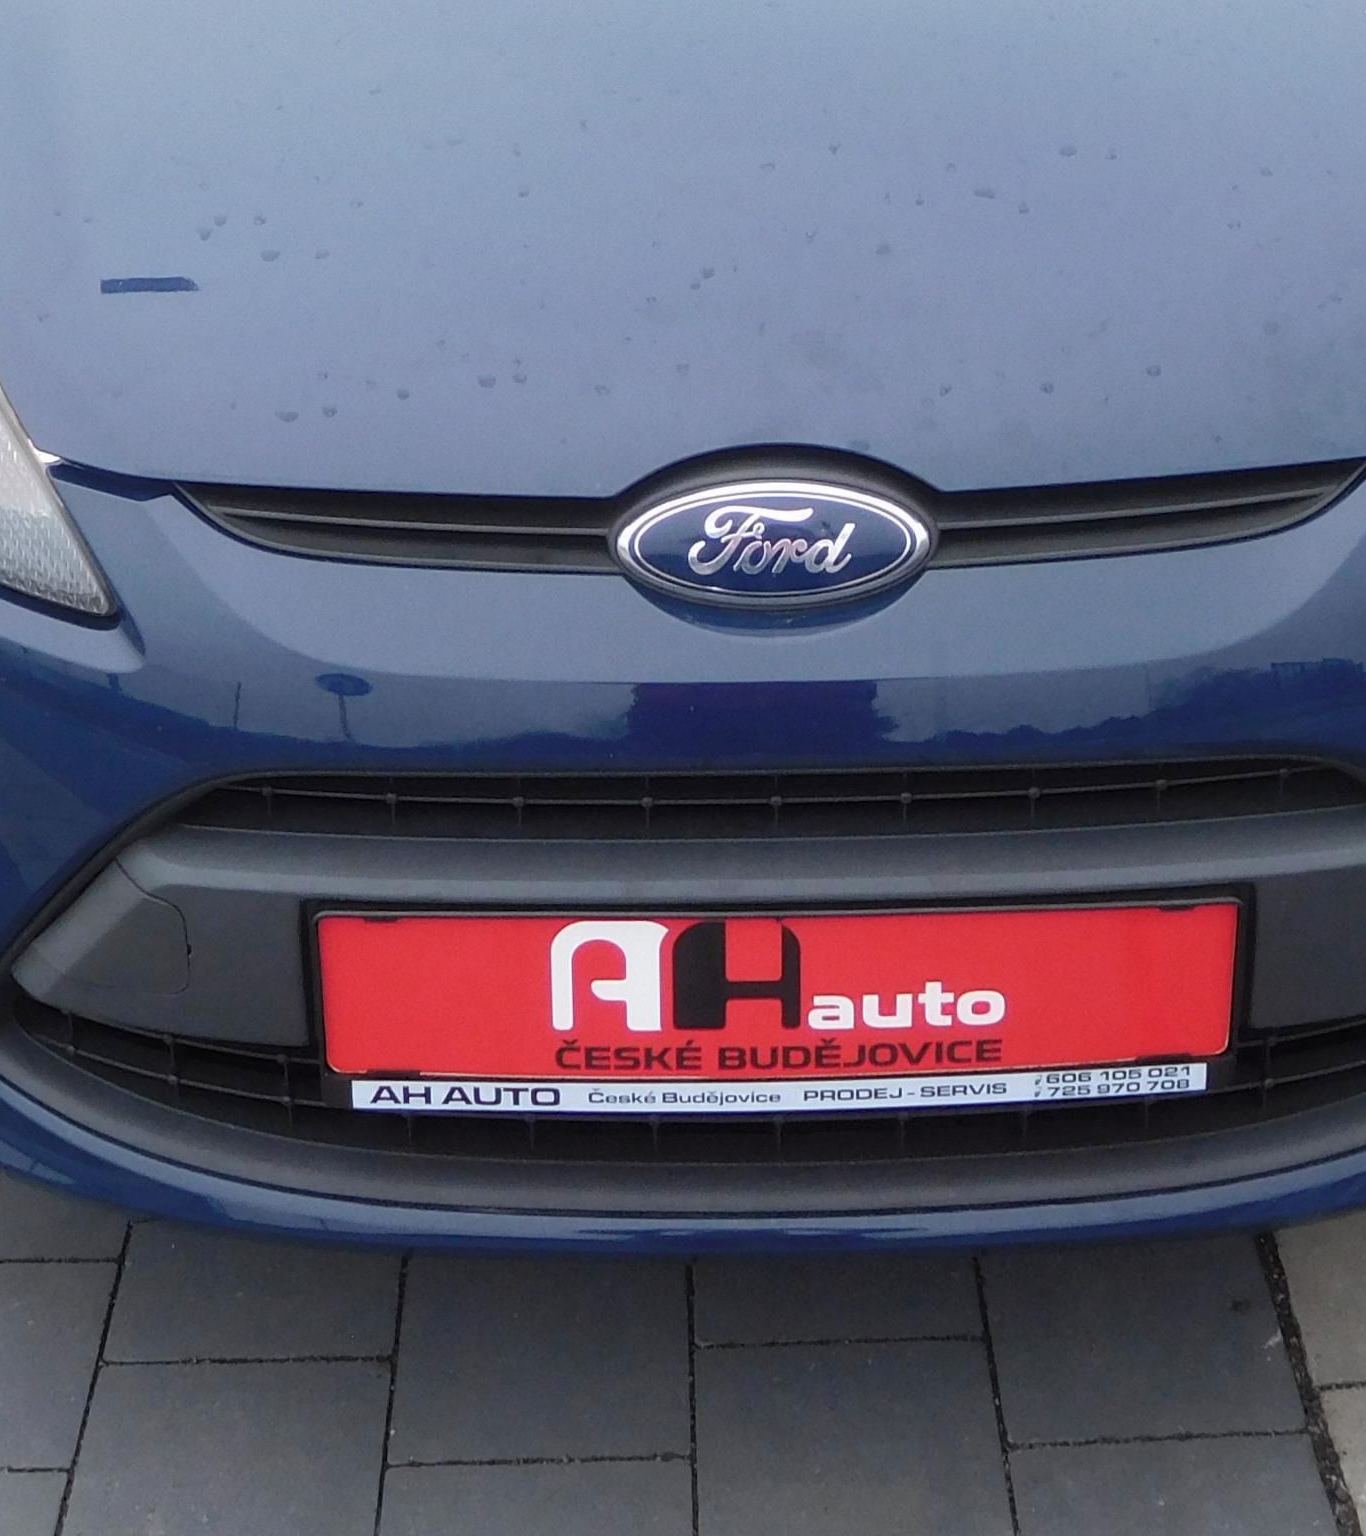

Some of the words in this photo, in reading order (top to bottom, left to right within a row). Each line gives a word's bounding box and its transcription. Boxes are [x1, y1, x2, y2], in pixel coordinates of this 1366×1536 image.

[688, 505, 856, 575] Ford
[555, 1039, 702, 1071] ČESKÉ
[718, 1037, 1002, 1071] BUDĚJOVICE
[1046, 1071, 1092, 1084] 606
[1100, 1069, 1142, 1081] 105
[1148, 1066, 1191, 1078] 021
[1046, 1084, 1091, 1097] 725
[1097, 1081, 1141, 1094] 970
[1147, 1078, 1190, 1092] 708
[370, 1085, 432, 1105] AH
[441, 1086, 561, 1107] AUTO
[588, 1088, 656, 1104] České
[662, 1089, 782, 1106] Budějovice
[920, 1082, 1008, 1098] SERVIS
